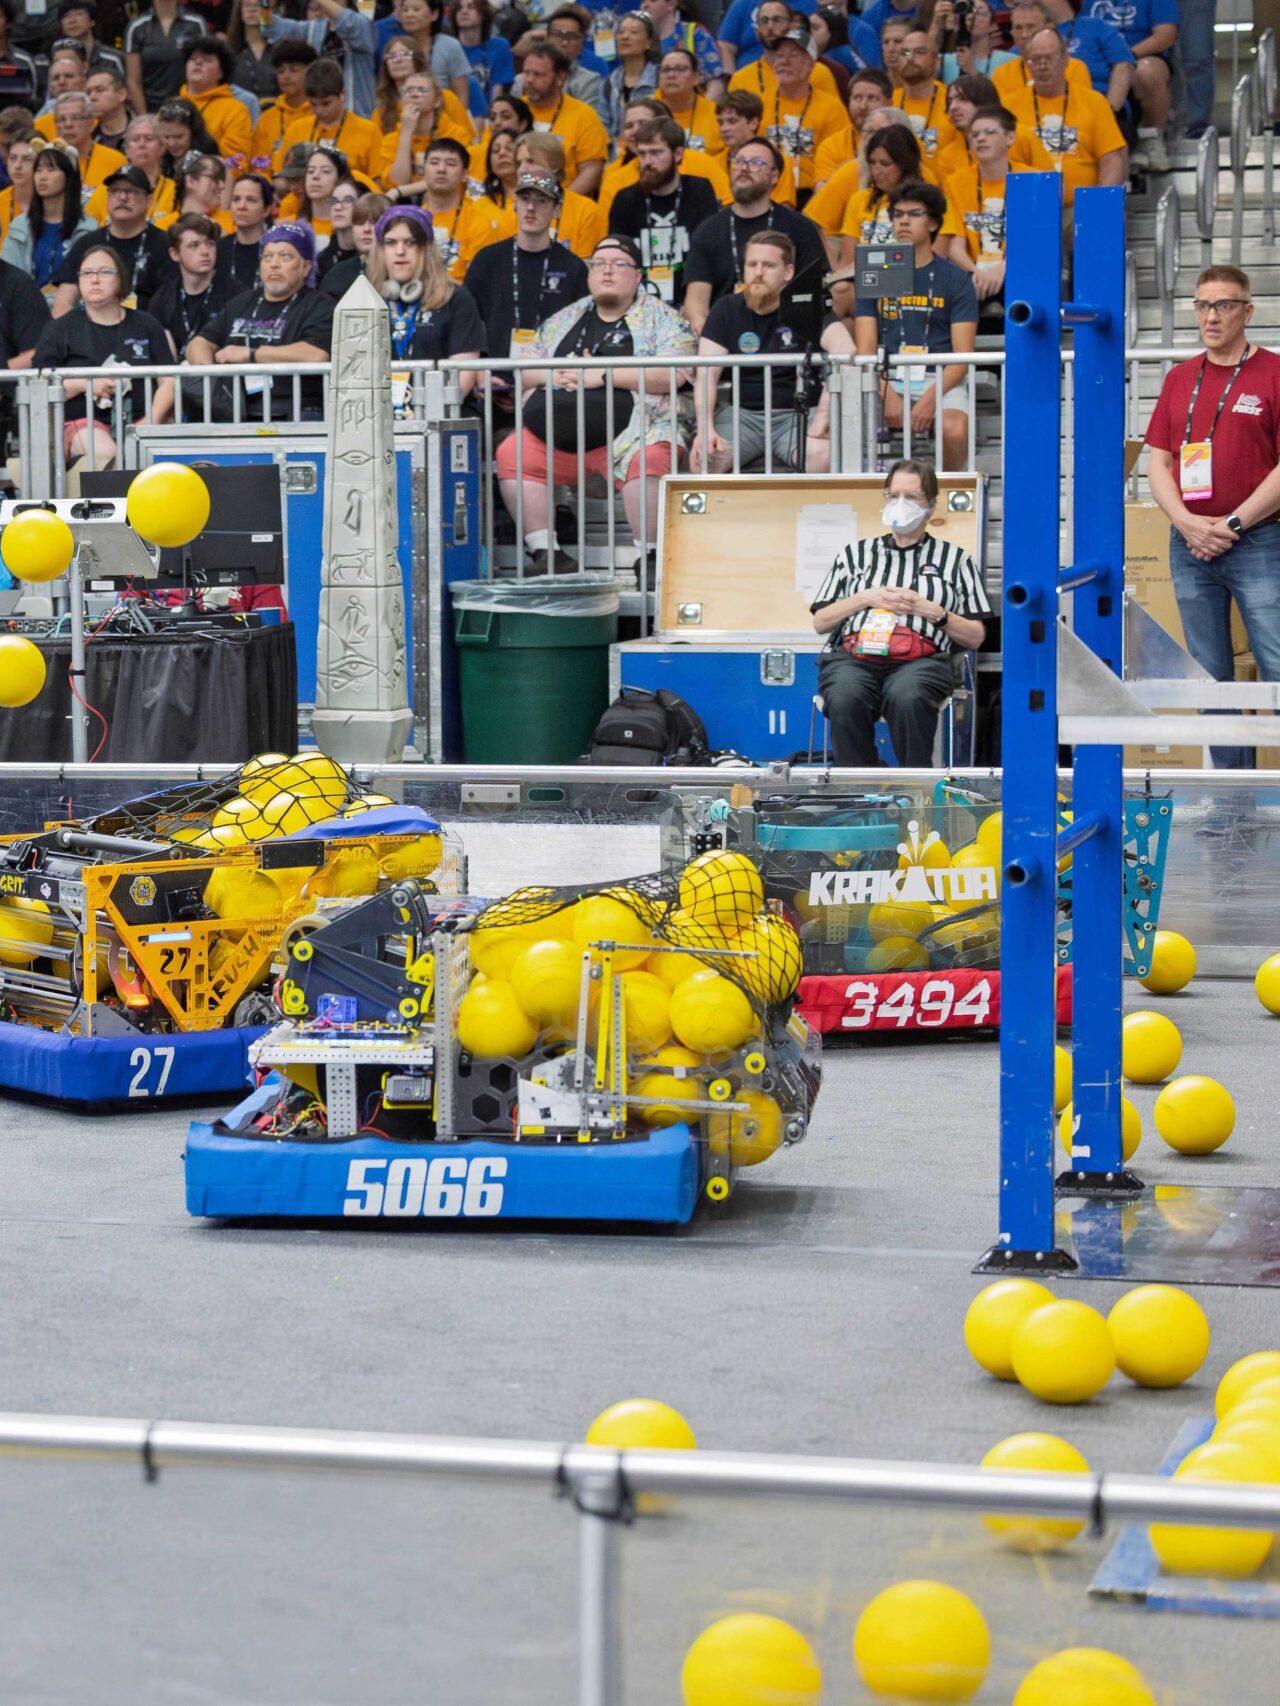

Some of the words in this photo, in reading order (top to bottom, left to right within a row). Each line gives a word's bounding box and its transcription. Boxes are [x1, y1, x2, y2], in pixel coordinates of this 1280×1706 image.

[0, 874, 25, 894] GRIT
[808, 866, 997, 906] KRAKATOA
[254, 923, 276, 932] White
[160, 947, 191, 975] 27
[208, 934, 259, 1011] RUSH
[841, 978, 991, 1027] 3494
[128, 1047, 175, 1097] 27
[343, 1157, 507, 1216] 5066
